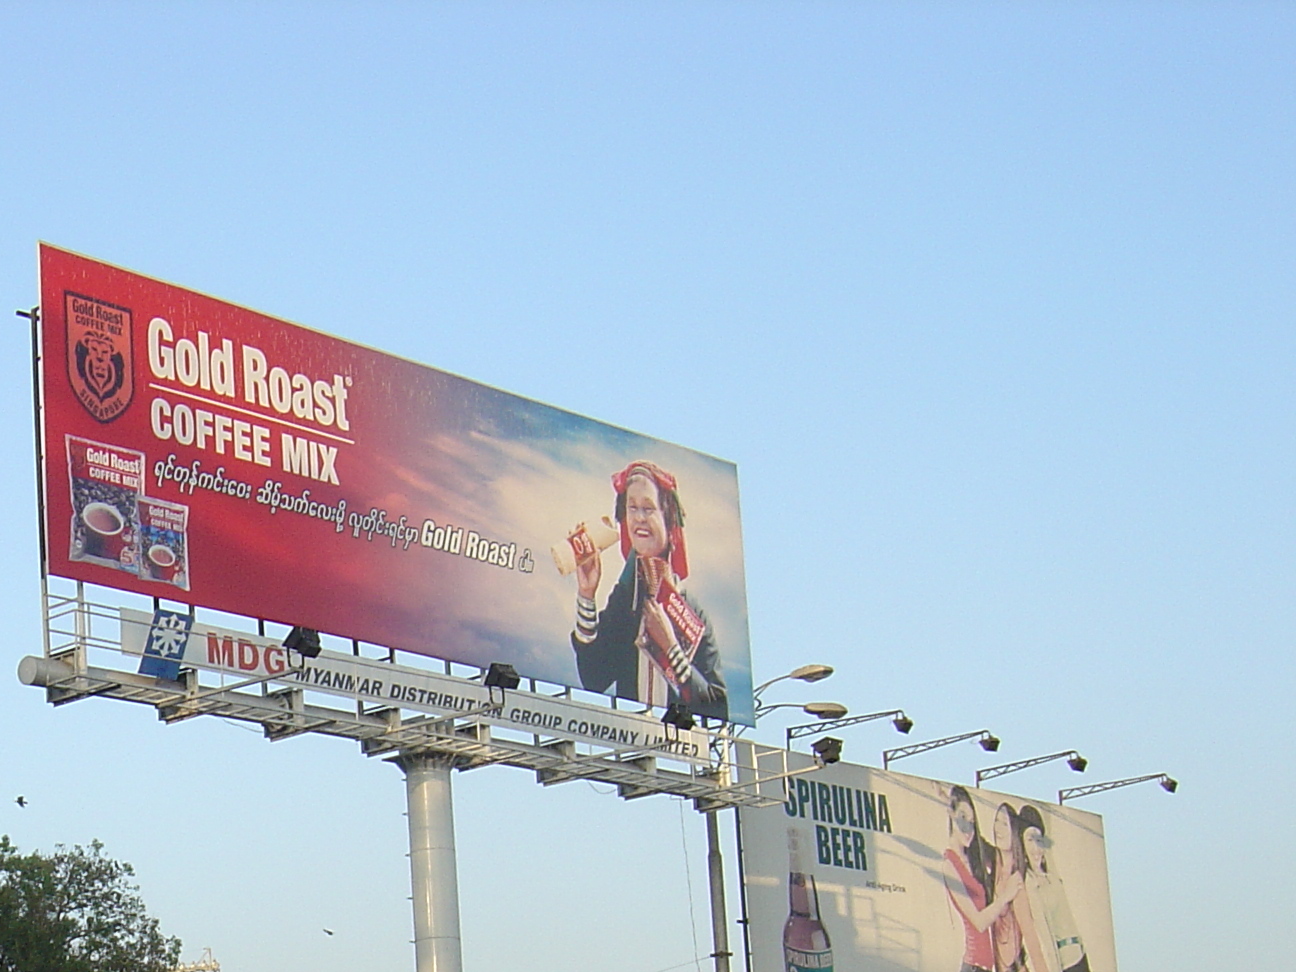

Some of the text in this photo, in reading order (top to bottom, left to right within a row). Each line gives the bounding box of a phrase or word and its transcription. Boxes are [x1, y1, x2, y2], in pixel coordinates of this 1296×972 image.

[72, 298, 123, 326] Gold Roast
[75, 314, 122, 336] COFFEE MIX
[148, 317, 234, 398] Gold
[79, 388, 124, 419] SINGAPORE
[86, 447, 139, 474] Gold Roast
[151, 397, 341, 486] COFFEE MIX
[89, 467, 139, 487] COFFEE MIX
[421, 520, 461, 555] Gold
[465, 532, 516, 569] Roast
[207, 631, 285, 675] MDG
[295, 666, 383, 696] MYANMAR
[510, 707, 563, 730] GROUP
[567, 719, 640, 746] COMPANY
[782, 775, 893, 834] SPIRULINA
[815, 824, 868, 871] BEER
